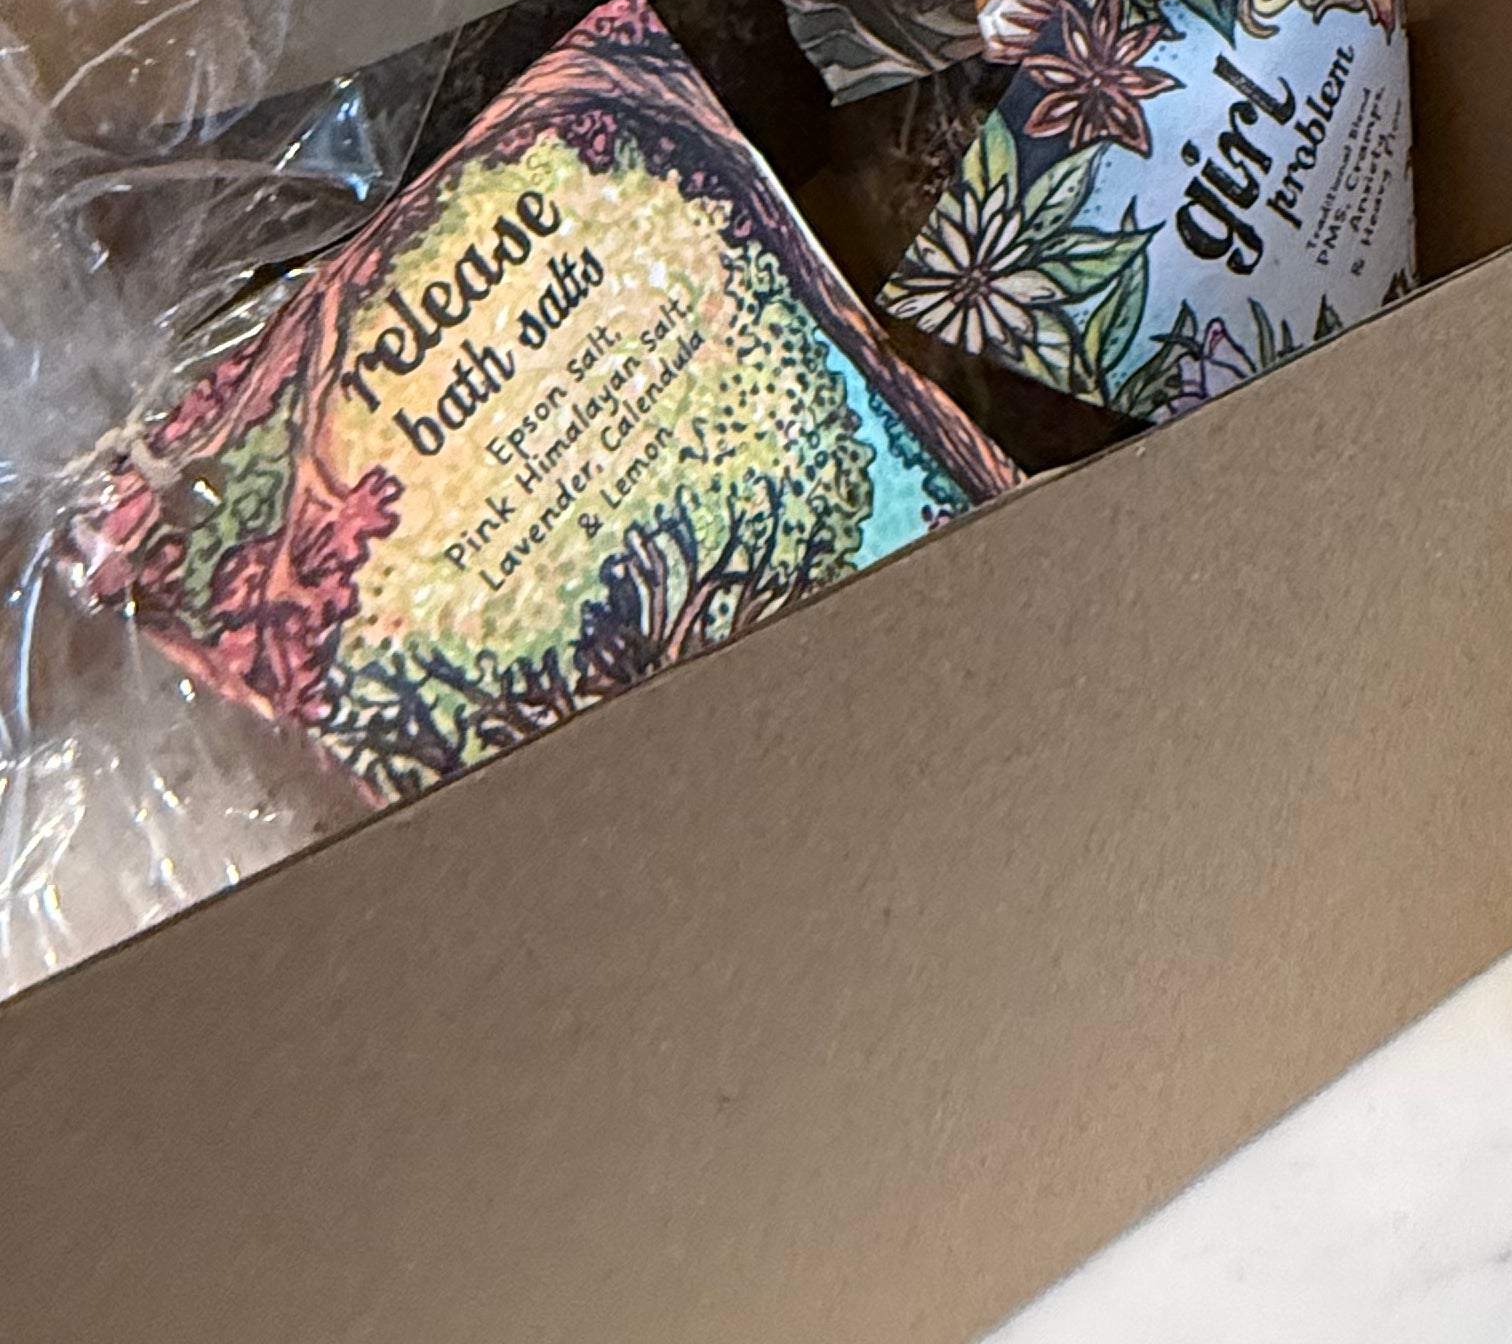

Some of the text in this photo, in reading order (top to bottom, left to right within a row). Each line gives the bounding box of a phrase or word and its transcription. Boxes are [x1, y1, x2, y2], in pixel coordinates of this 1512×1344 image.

[1176, 52, 1296, 275] girl
[1266, 44, 1354, 230] problem
[1306, 145, 1352, 250] Traditional
[340, 191, 561, 413] release
[393, 246, 604, 456] bath salts
[444, 494, 516, 571] Pink
[514, 354, 642, 494] Himalayan
[479, 329, 707, 592] Lavender, Calendula
[485, 383, 568, 465] Epson
[577, 425, 673, 539] & Lemon
